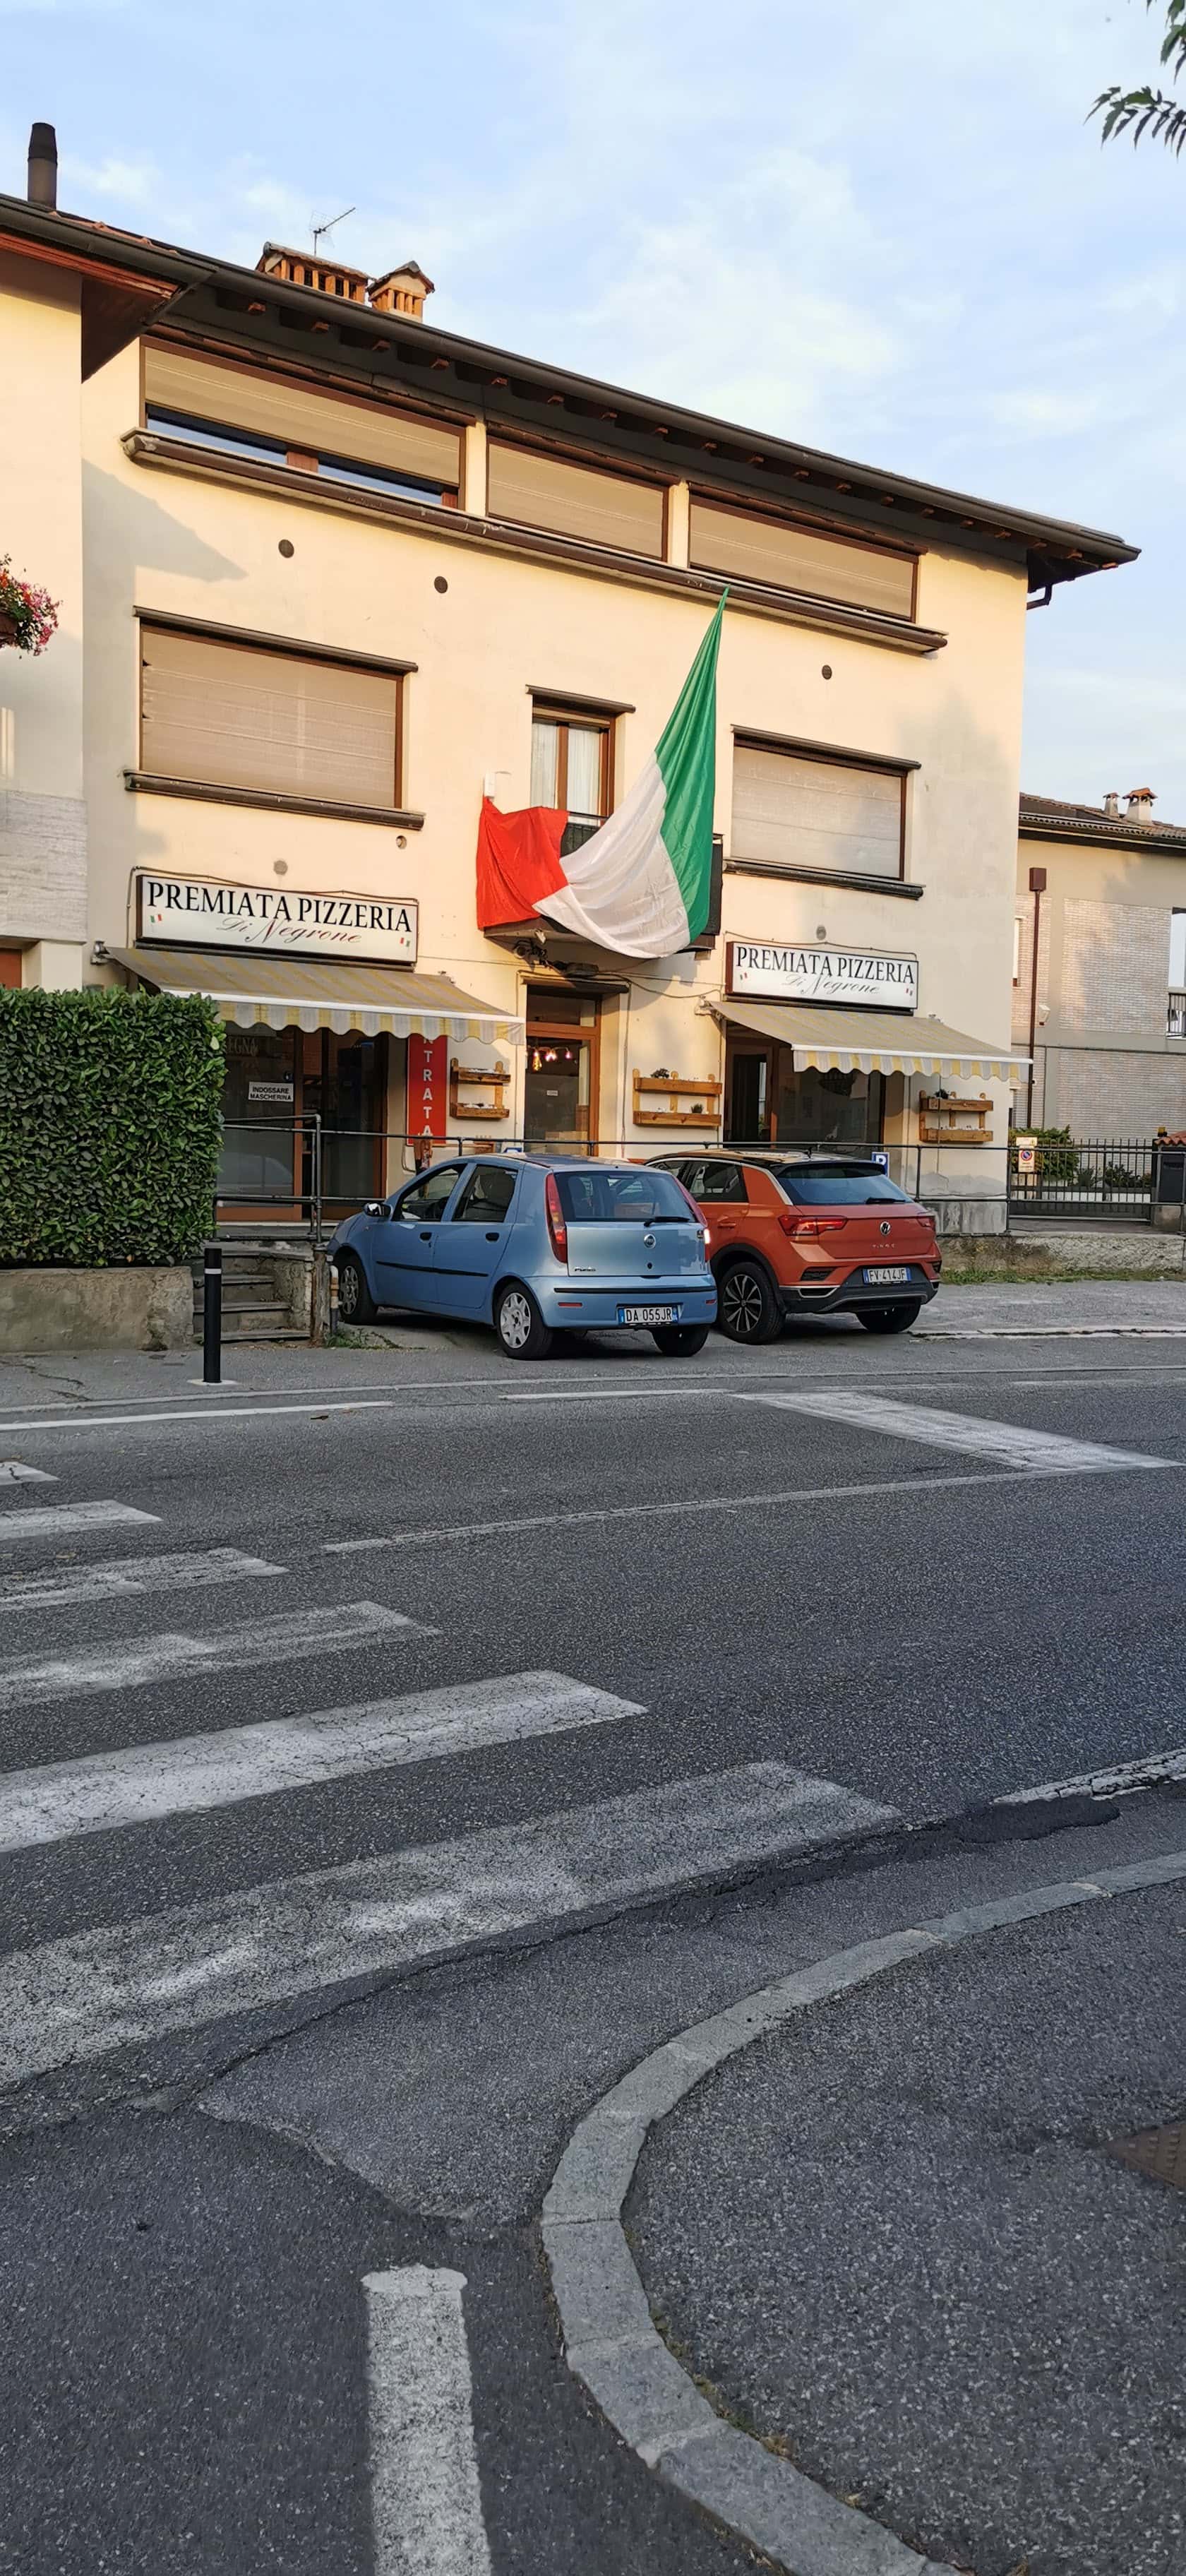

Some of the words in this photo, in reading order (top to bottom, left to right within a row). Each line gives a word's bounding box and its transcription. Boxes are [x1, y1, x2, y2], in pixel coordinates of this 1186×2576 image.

[147, 881, 292, 921] PREMIATA
[297, 898, 412, 932] PIZZERIA
[216, 917, 251, 931] Di
[244, 917, 362, 944] Negrone
[736, 946, 832, 977] PREMIATA
[837, 957, 915, 984] PIZZERIA
[801, 974, 881, 995] Negrone
